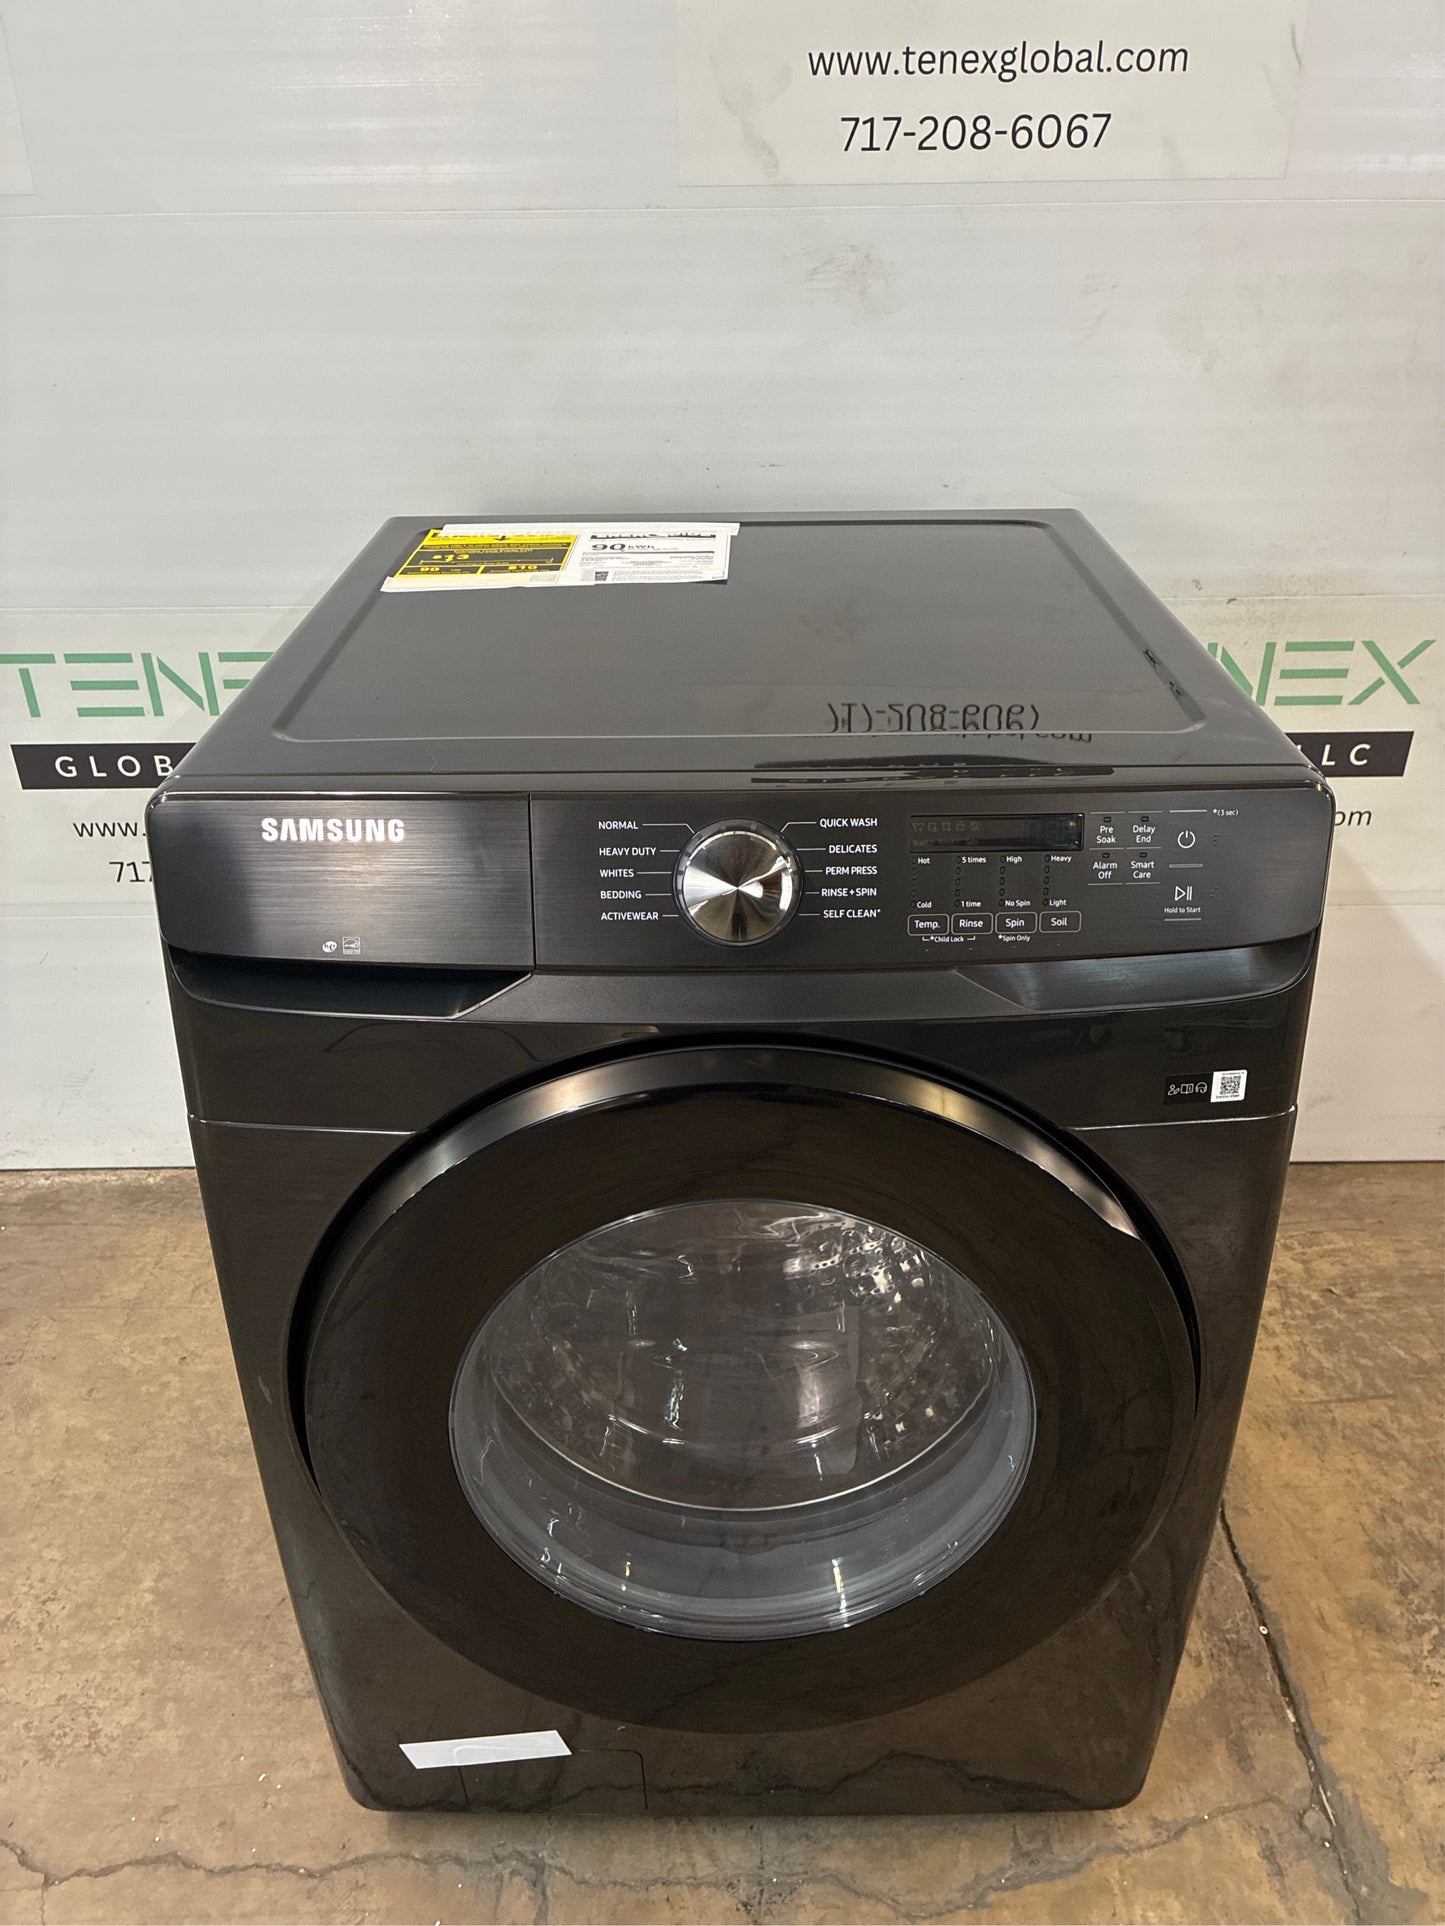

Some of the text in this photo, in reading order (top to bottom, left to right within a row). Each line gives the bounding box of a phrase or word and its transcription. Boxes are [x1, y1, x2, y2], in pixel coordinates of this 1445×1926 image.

[808, 41, 1189, 82] www.tenexglobal.com
[839, 114, 1112, 152] 717-208-6067
[599, 821, 638, 830] NORMAL
[820, 818, 877, 828] QUICK WASH
[262, 818, 404, 841] SAMSUNG
[1100, 825, 1113, 833] Pre
[1133, 825, 1155, 834] Delay
[1097, 835, 1116, 843] Soak
[1136, 835, 1151, 843] End
[600, 847, 656, 856] HEAVY DUTY
[829, 844, 877, 853] DELICATES
[1131, 861, 1154, 869] Smart
[600, 869, 634, 878] WHITES
[826, 866, 877, 875] PERM PRESS
[1098, 871, 1112, 879] Off
[601, 890, 641, 899] BEDDING
[601, 912, 658, 921] ACTIVEWEAR
[823, 910, 844, 919] SELF
[915, 920, 940, 929] Temp.
[960, 919, 983, 927] Rinse
[1006, 919, 1024, 927] Spin
[1051, 918, 1067, 926] Soil
